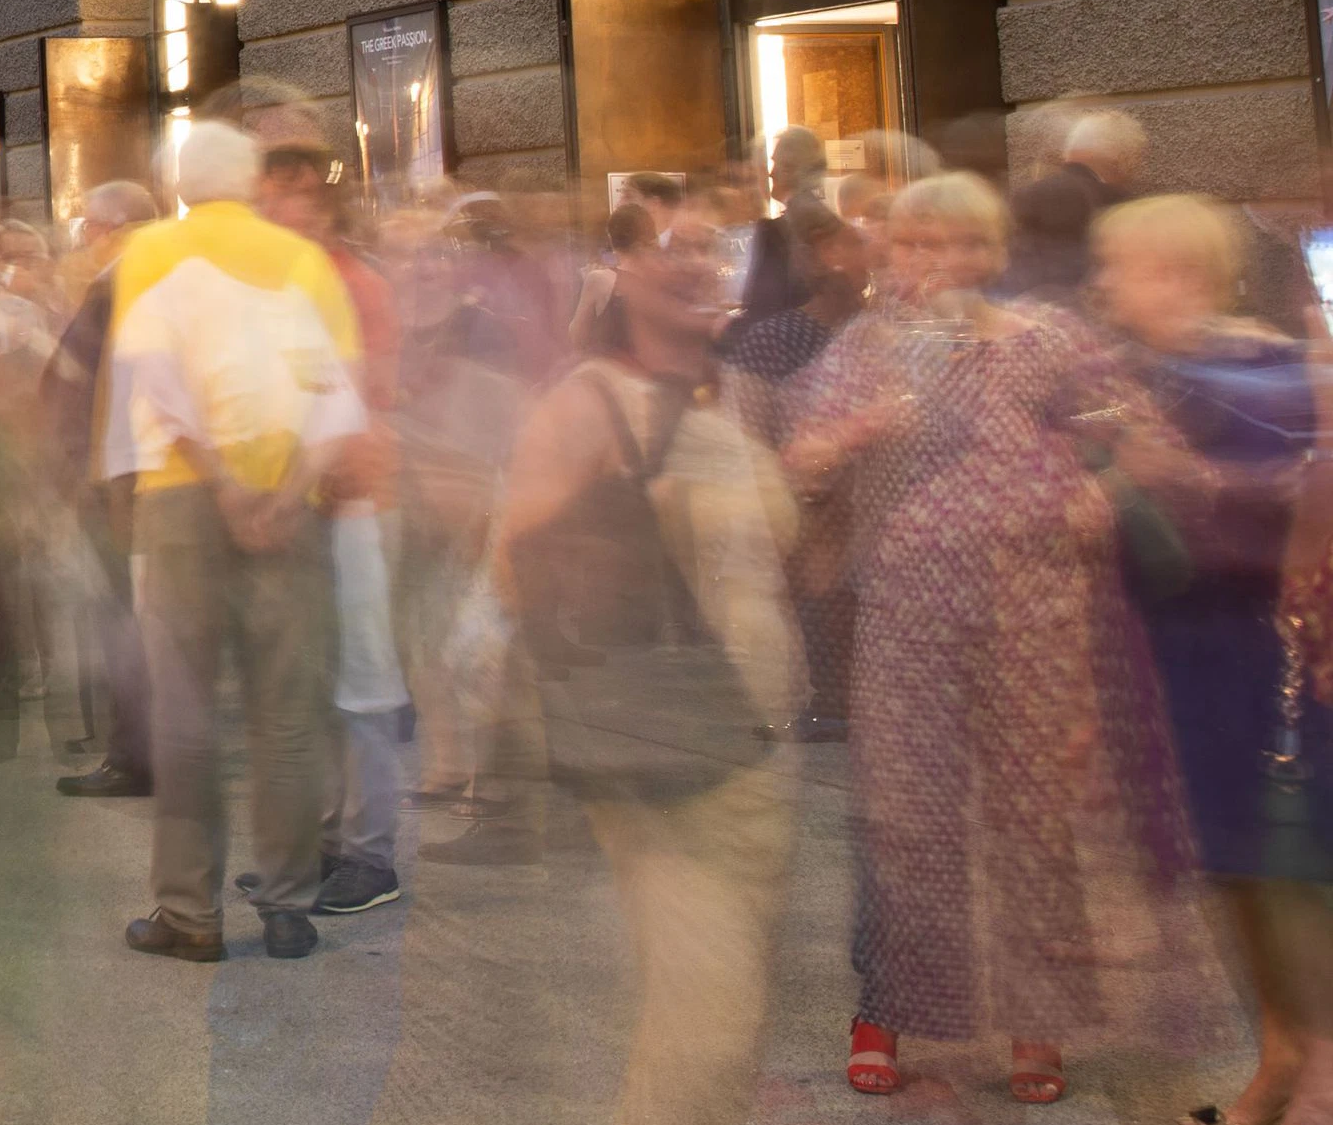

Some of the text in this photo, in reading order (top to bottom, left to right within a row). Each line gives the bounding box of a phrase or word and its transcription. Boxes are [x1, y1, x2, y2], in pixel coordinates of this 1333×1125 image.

[361, 38, 375, 55] THE
[375, 35, 397, 52] GREEK
[396, 29, 428, 48] PASSION
